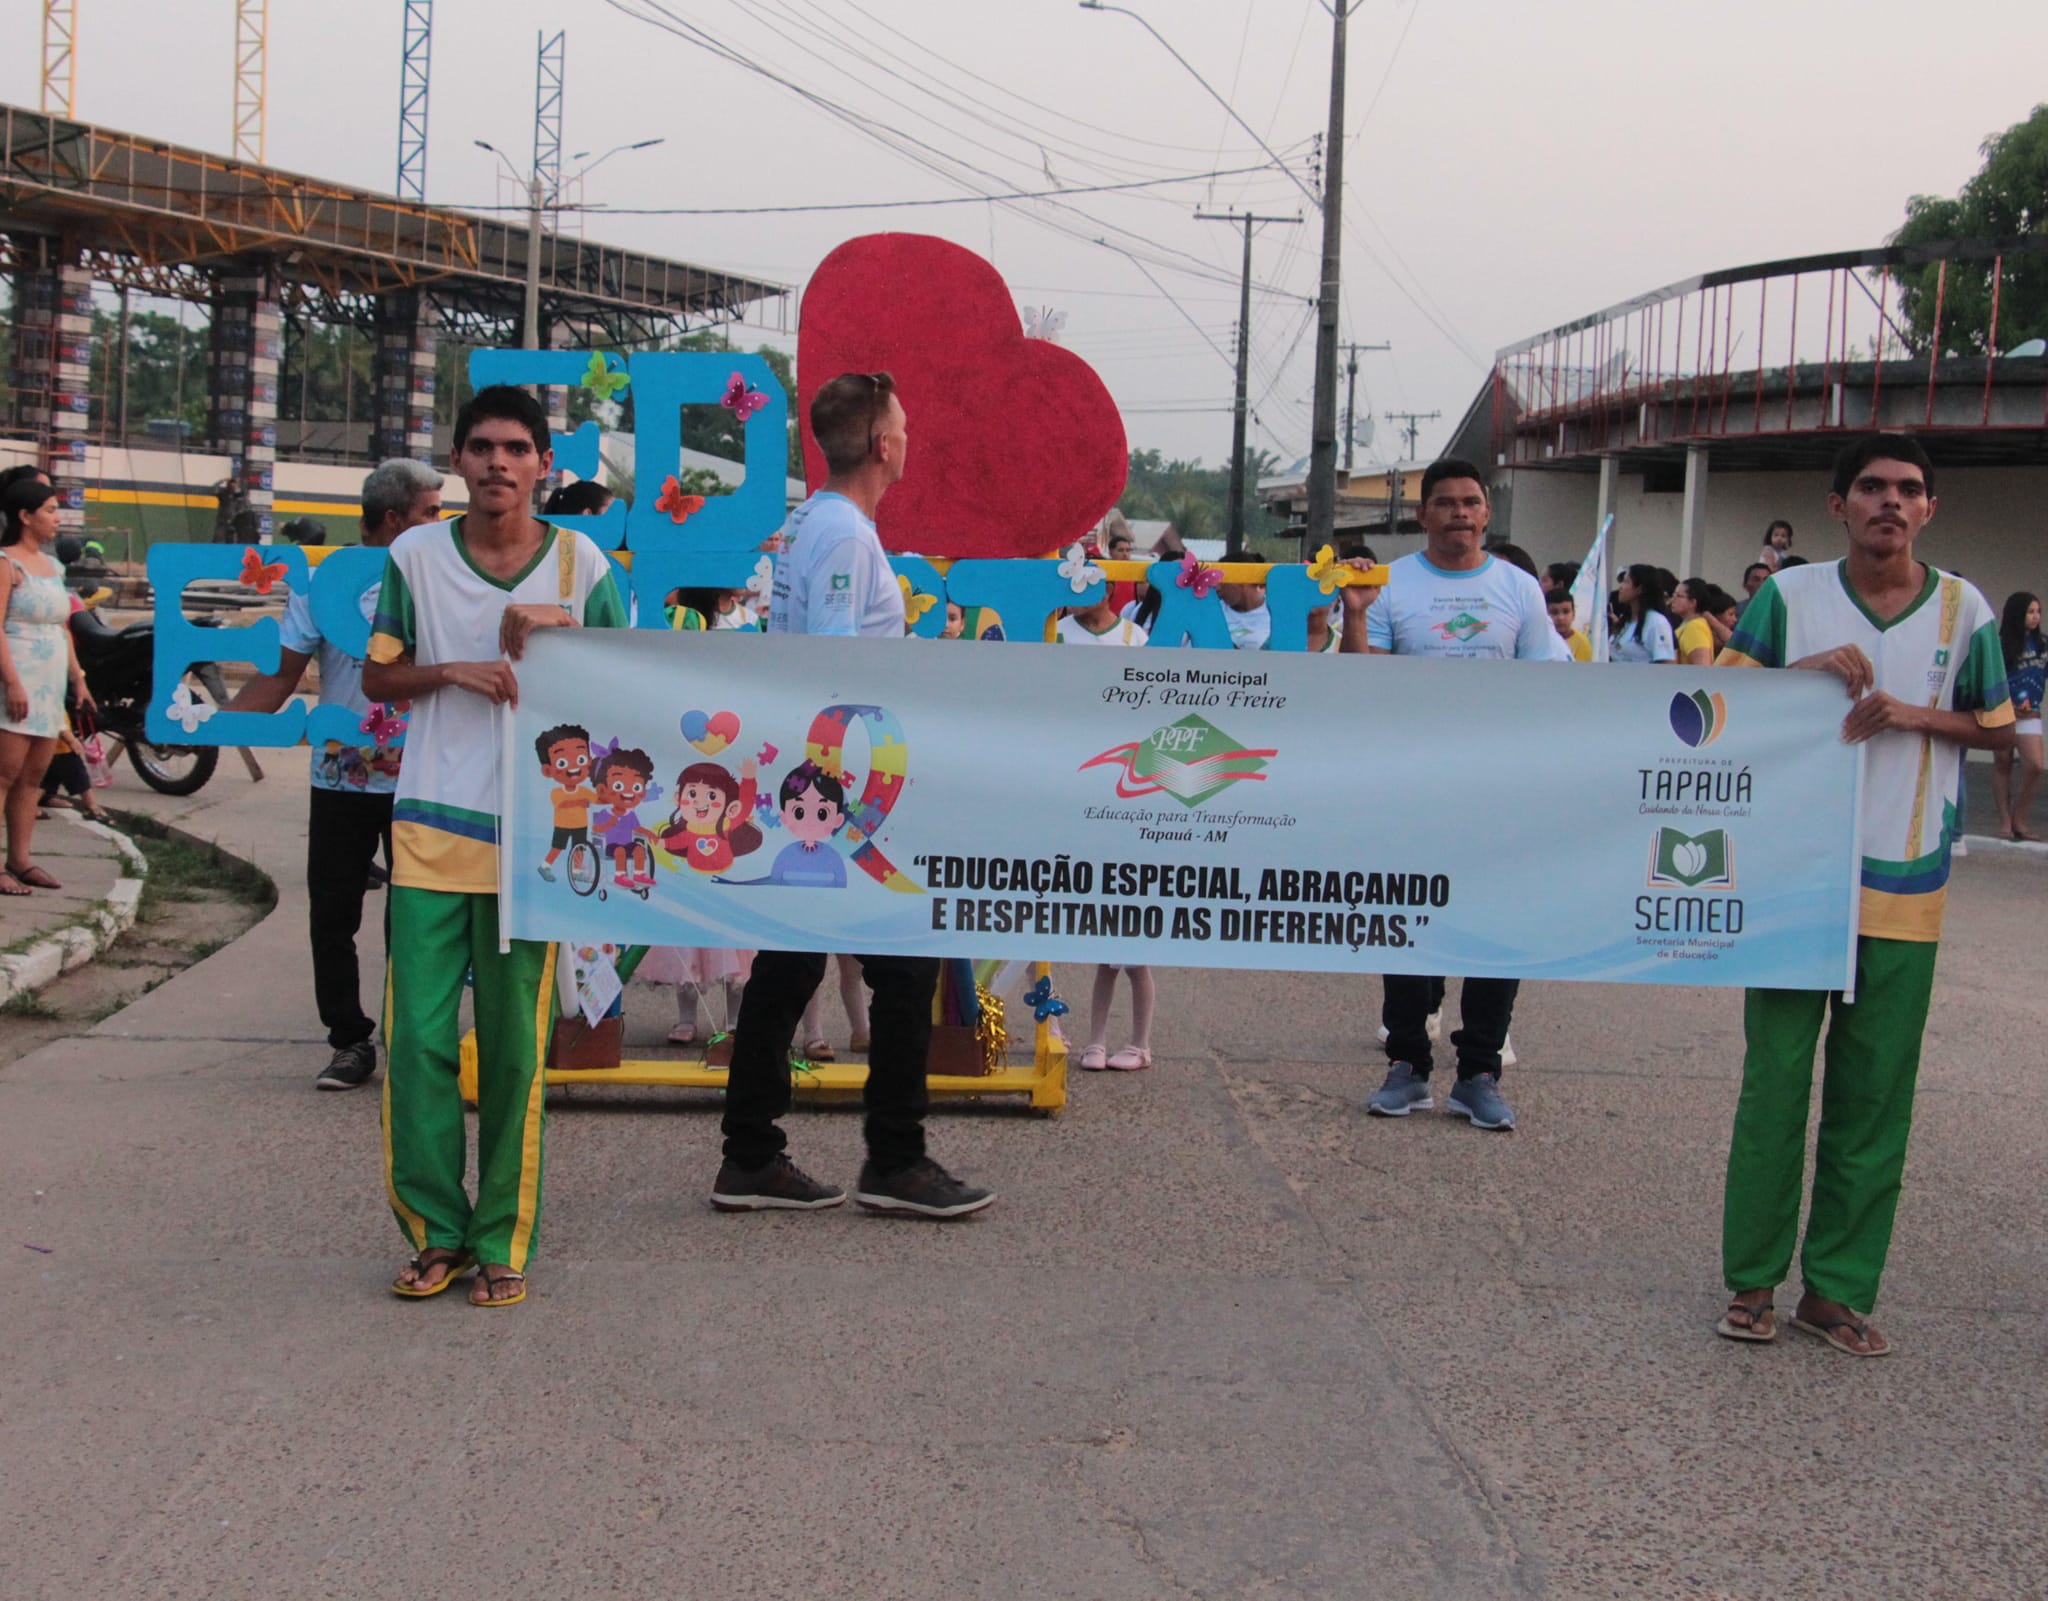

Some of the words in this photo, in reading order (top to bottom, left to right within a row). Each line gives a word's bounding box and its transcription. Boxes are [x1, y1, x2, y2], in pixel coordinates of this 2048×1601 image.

[1123, 667, 1180, 683] Escola
[1186, 669, 1268, 688] Municipal
[1102, 685, 1154, 710] Prof.
[1159, 687, 1220, 707] Paulo
[1226, 689, 1287, 709] Freire
[1658, 757, 1717, 766] PREFEITURA
[1721, 759, 1734, 767] DE
[1638, 766, 1752, 803] TAPAUÁ
[1083, 806, 1153, 824] Educação
[1156, 812, 1188, 825] para
[1192, 809, 1297, 829] Transformação
[1682, 804, 1693, 816] da
[1695, 804, 1721, 817] Nossa
[1138, 826, 1192, 843] Tapauá
[1203, 829, 1228, 843] AM
[913, 853, 1094, 899] “EDUCAÇÃO
[1101, 862, 1251, 904] ESPECIAL,
[1258, 868, 1450, 911] ABRAÇANDO
[931, 897, 948, 930] E
[955, 898, 1164, 939] RESPEITANDO
[1171, 906, 1212, 941] AS
[1220, 908, 1430, 953] DIFERENÇAS.”
[1635, 895, 1744, 934] SEMED
[1635, 936, 1686, 947] Secretaria
[1687, 938, 1735, 949] Municipal
[1656, 950, 1670, 959] de
[1672, 950, 1719, 961] Educação
